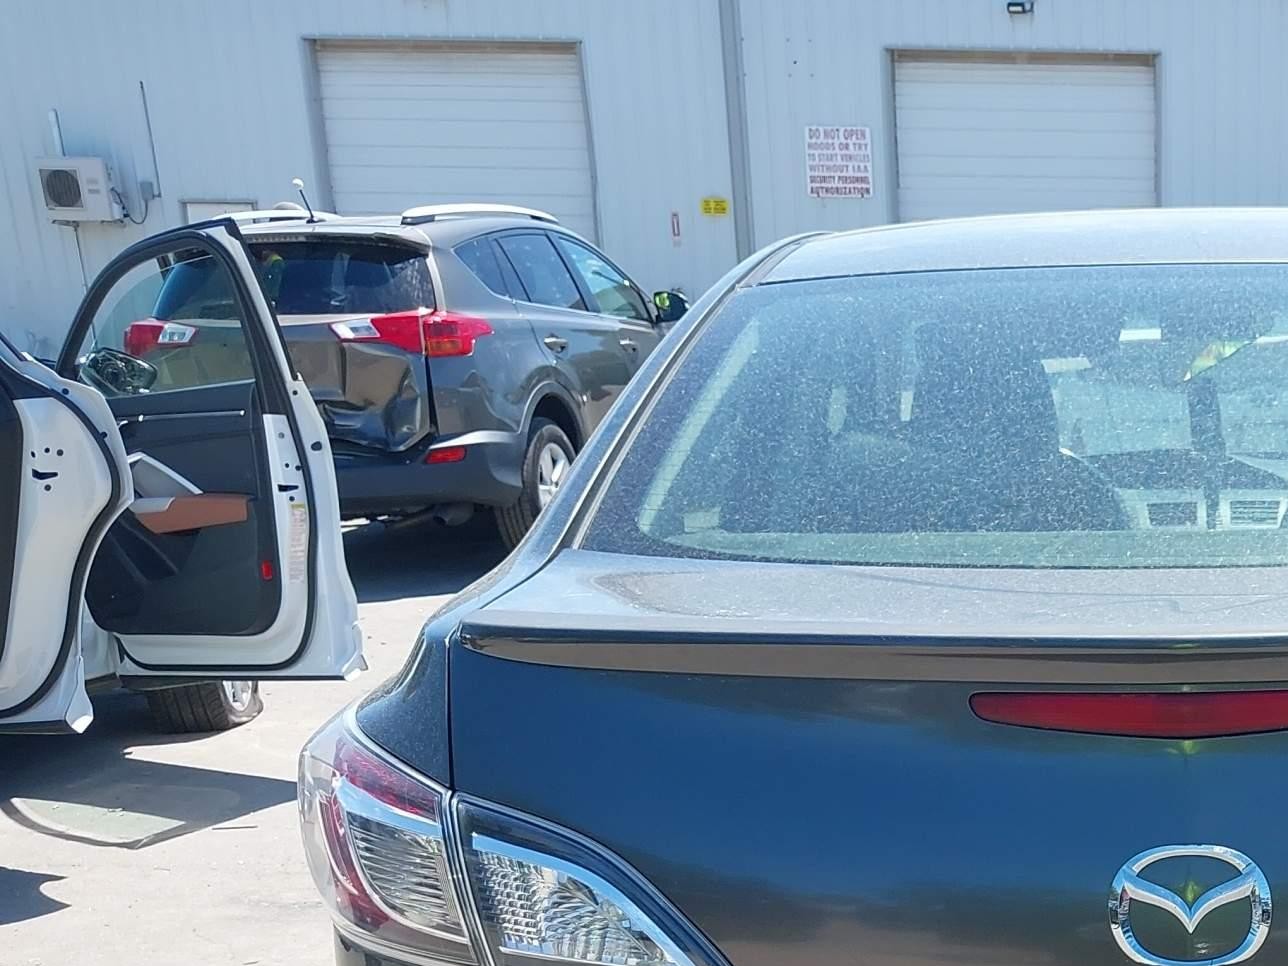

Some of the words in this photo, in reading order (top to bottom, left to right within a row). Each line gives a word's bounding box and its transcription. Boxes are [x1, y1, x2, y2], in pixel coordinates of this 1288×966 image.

[808, 127, 821, 140] DO
[823, 127, 840, 141] NOT
[843, 128, 867, 141] OPEN
[838, 142, 850, 152] OR
[852, 142, 868, 152] TRY
[807, 152, 816, 162] TO
[817, 152, 838, 163] START
[808, 164, 849, 174] WITHOUT
[809, 175, 836, 184] SECURITY
[837, 175, 871, 185] PERSONNEL
[810, 186, 871, 196] AUTHORIZATION
